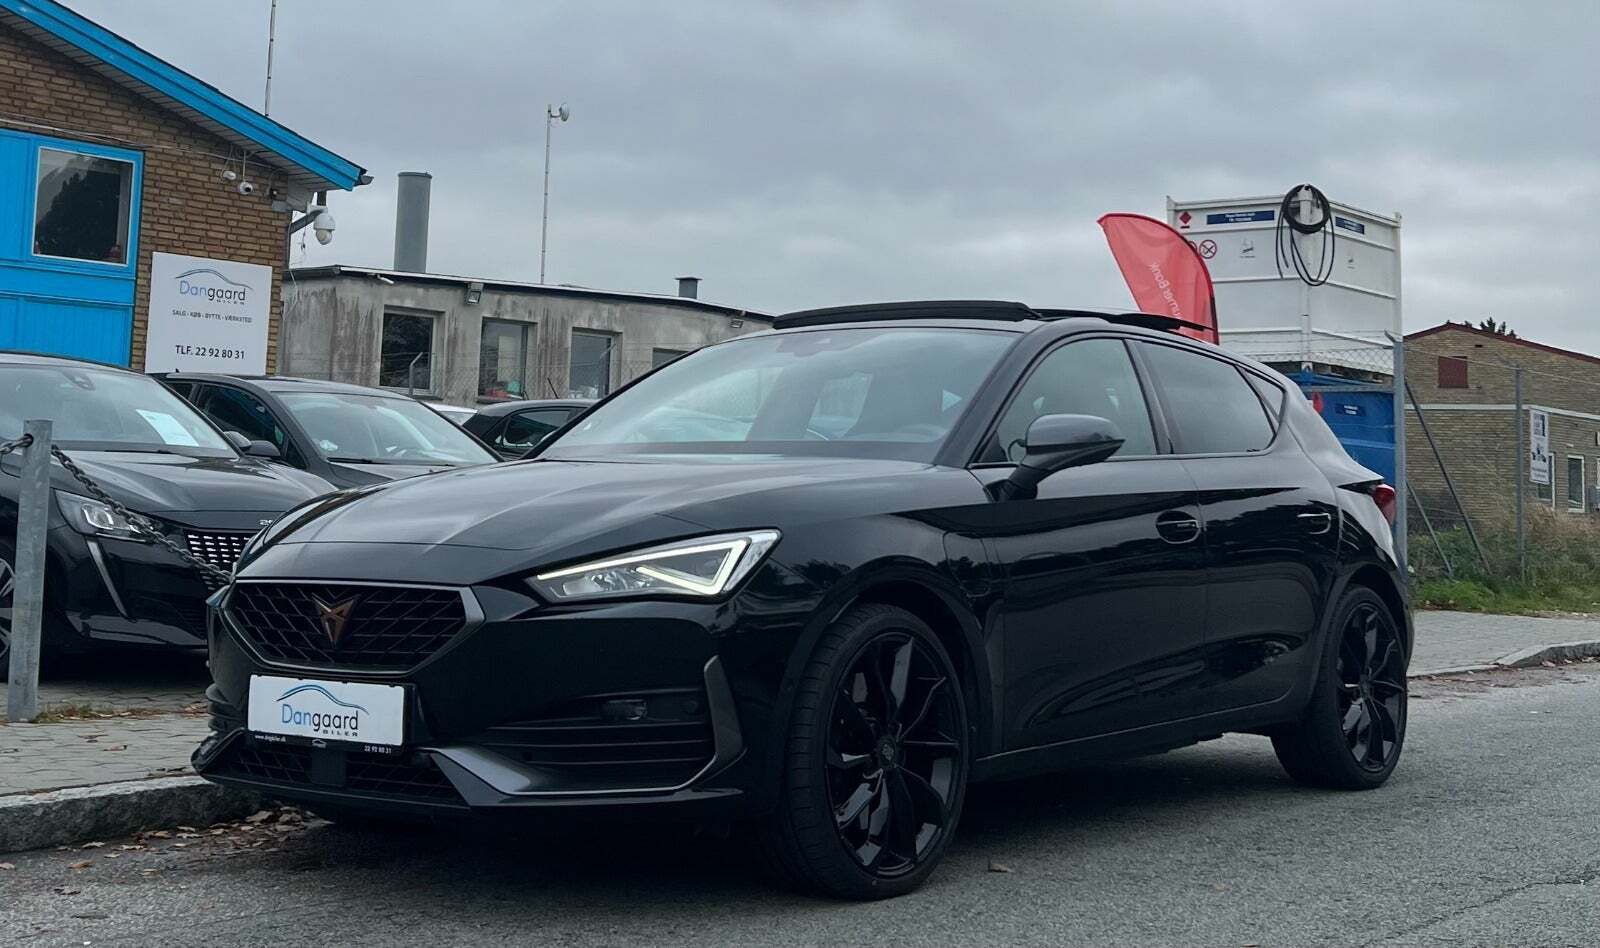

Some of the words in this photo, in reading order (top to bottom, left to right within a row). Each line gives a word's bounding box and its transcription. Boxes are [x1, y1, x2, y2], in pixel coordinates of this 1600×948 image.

[180, 280, 246, 301] Dangaard
[172, 309, 187, 317] SALG
[175, 344, 194, 356] TLF.
[195, 346, 207, 357] 22
[208, 347, 220, 358] 92
[221, 349, 233, 359] 80
[234, 350, 245, 360] 31
[281, 703, 359, 732] Dangaard
[322, 729, 358, 737] BILER
